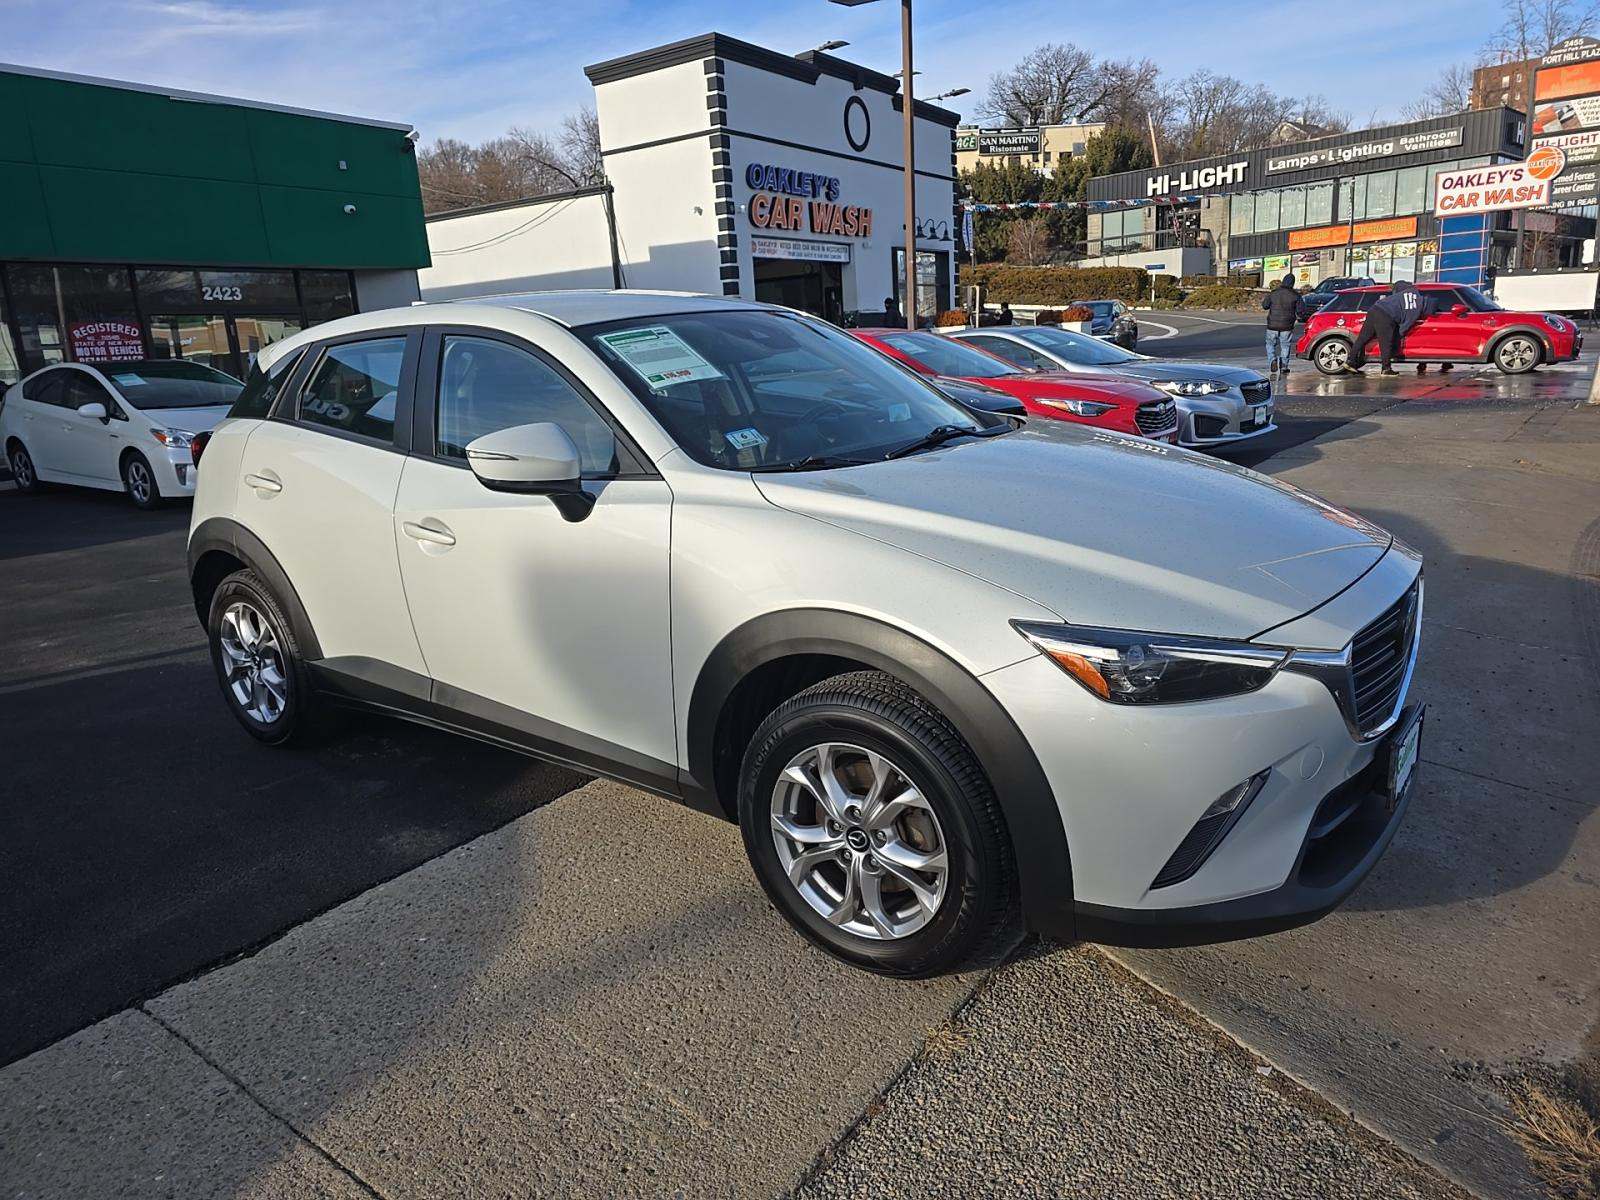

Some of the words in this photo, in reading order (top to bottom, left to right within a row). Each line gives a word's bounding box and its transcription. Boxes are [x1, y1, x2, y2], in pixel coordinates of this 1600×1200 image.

[1564, 39, 1584, 48] 2455
[1542, 54, 1563, 65] FORT
[1563, 51, 1579, 61] HILL
[1581, 47, 1600, 58] PLAZ
[980, 137, 998, 146] SAN
[999, 135, 1039, 145] MARTINO
[1399, 129, 1459, 146] Bathroom
[1404, 137, 1453, 152] Vanities
[1535, 133, 1599, 149] HI-LIGHT
[989, 144, 1029, 153] Ristorante
[1268, 154, 1319, 172] Lamps
[1328, 141, 1395, 162] Lighting
[746, 163, 840, 201] OAKLEY'S
[1147, 161, 1248, 197] HI-LIGHT
[1442, 168, 1524, 191] OAKLEY'S
[1574, 171, 1596, 181] Forces
[1572, 182, 1596, 192] Center
[1439, 191, 1480, 211] CAR
[1484, 184, 1545, 206] WASH
[1577, 197, 1598, 206] REAR
[748, 193, 804, 231] CAR
[808, 201, 873, 237] WASH
[202, 286, 242, 300] 2423
[73, 322, 139, 338] REGISTERED
[76, 347, 106, 356] MOTOR
[109, 346, 144, 355] VEHICLE
